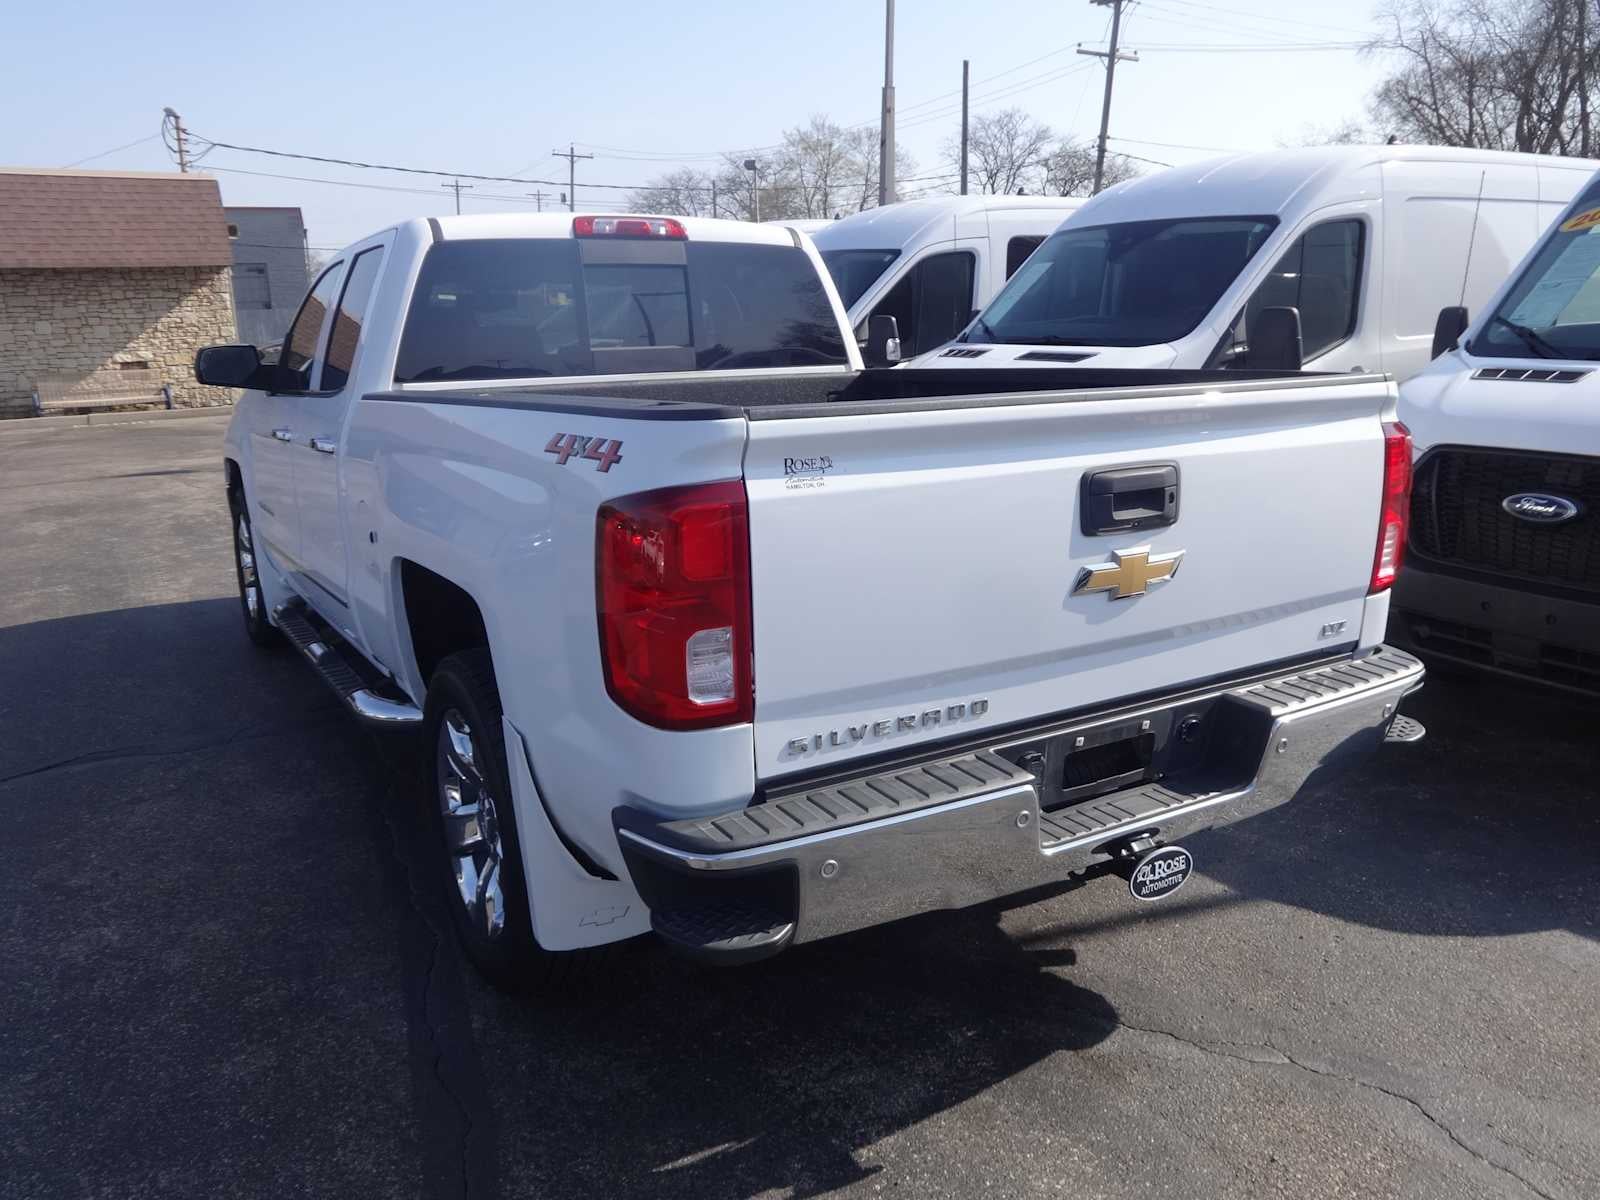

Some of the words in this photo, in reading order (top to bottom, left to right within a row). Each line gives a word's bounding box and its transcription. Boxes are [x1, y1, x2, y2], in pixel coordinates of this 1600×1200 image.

[784, 457, 817, 475] ROSE
[1515, 497, 1558, 514] Ford
[1322, 619, 1347, 637] LTZ
[788, 698, 989, 757] SILVERADO
[1141, 873, 1183, 895] AUTOMOTIVE
